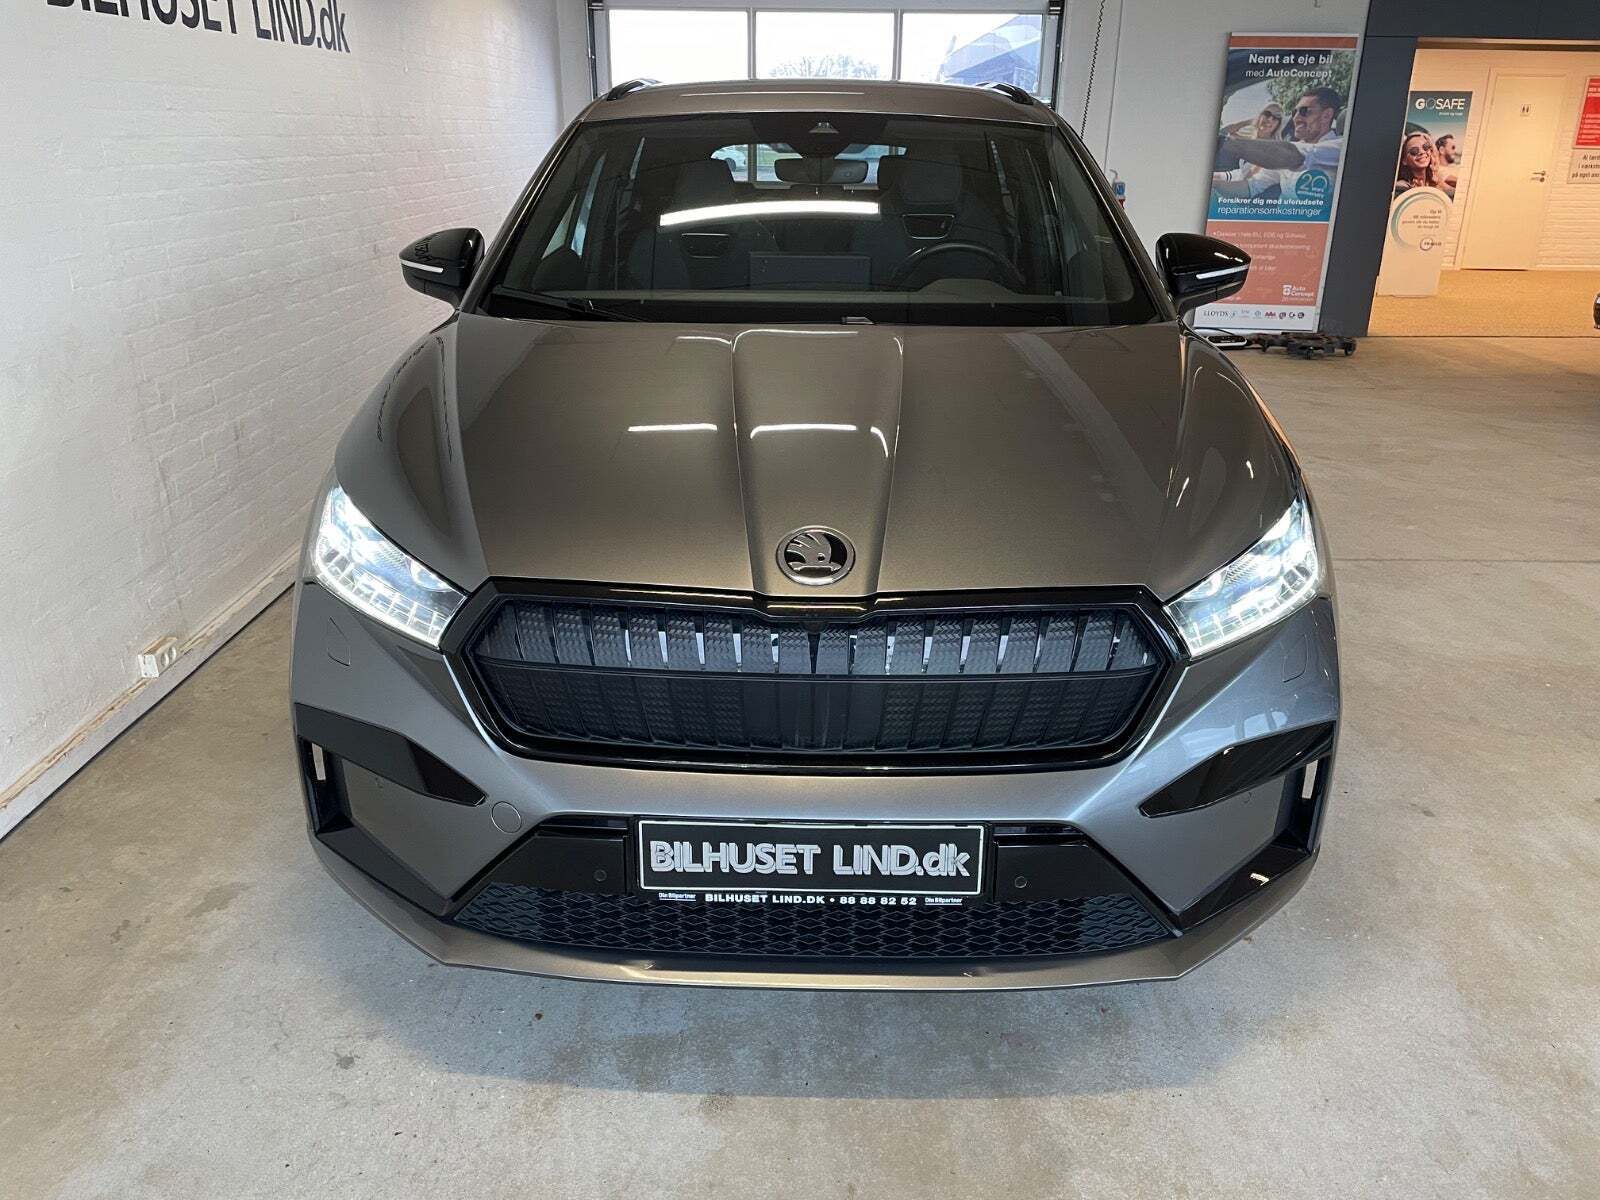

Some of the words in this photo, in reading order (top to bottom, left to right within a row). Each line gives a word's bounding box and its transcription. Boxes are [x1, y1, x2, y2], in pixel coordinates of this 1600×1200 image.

[1248, 54, 1280, 64] Nemt
[1283, 54, 1295, 64] at
[1297, 54, 1315, 66] eje
[1319, 54, 1333, 64] bil
[1245, 69, 1264, 77] med
[1266, 68, 1332, 79] AutoConcept
[1415, 98, 1466, 110] GOSAFE
[1253, 197, 1264, 206] dig
[1283, 198, 1324, 206] uforudsete
[1217, 206, 1321, 217] reparationsomkostninger
[650, 840, 821, 875] BILHUSET
[832, 843, 971, 877] LIND.dk
[705, 893, 768, 903] BILHUSET
[772, 894, 825, 904] LIND.DK
[840, 896, 856, 905] 88
[860, 896, 876, 905] 88
[880, 896, 897, 906] 82
[900, 896, 917, 906] 52
